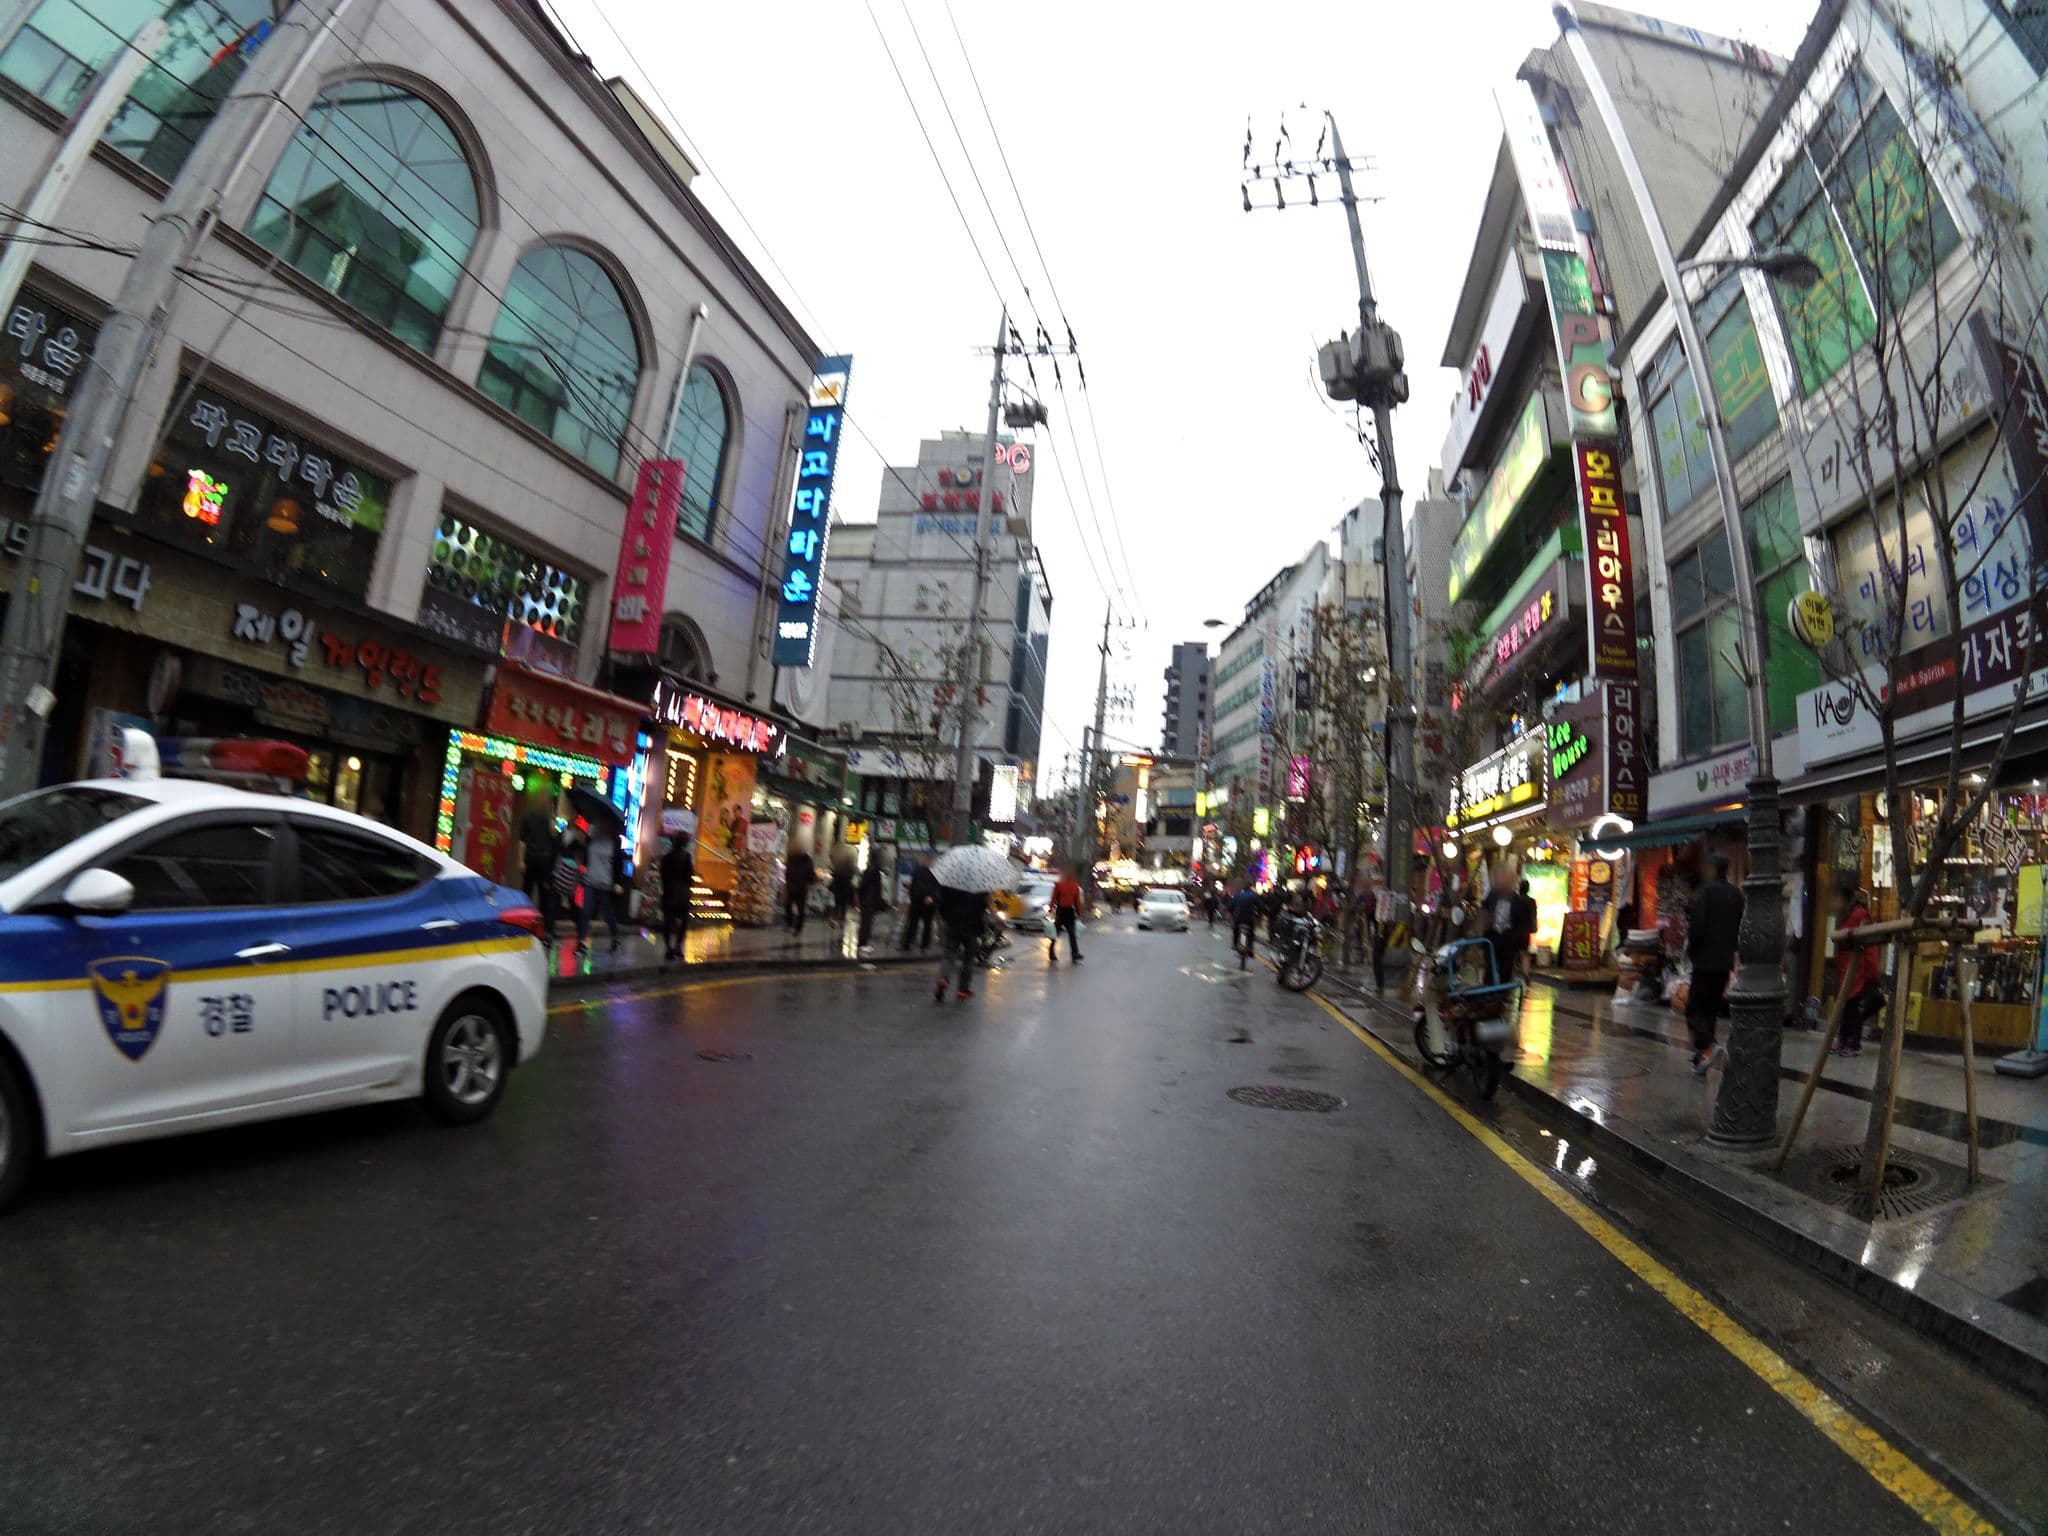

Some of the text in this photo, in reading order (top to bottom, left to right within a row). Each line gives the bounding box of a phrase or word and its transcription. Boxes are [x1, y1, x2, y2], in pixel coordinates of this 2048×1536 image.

[1560, 311, 1612, 414] PC
[190, 399, 364, 514] 파고다타운
[1964, 552, 2021, 613] 의상
[233, 602, 315, 669] 제일
[1918, 664, 1946, 685] Spirits
[1614, 686, 1636, 789] 리하우스
[199, 993, 253, 1038] 경찰
[322, 980, 418, 1021] POLICE
